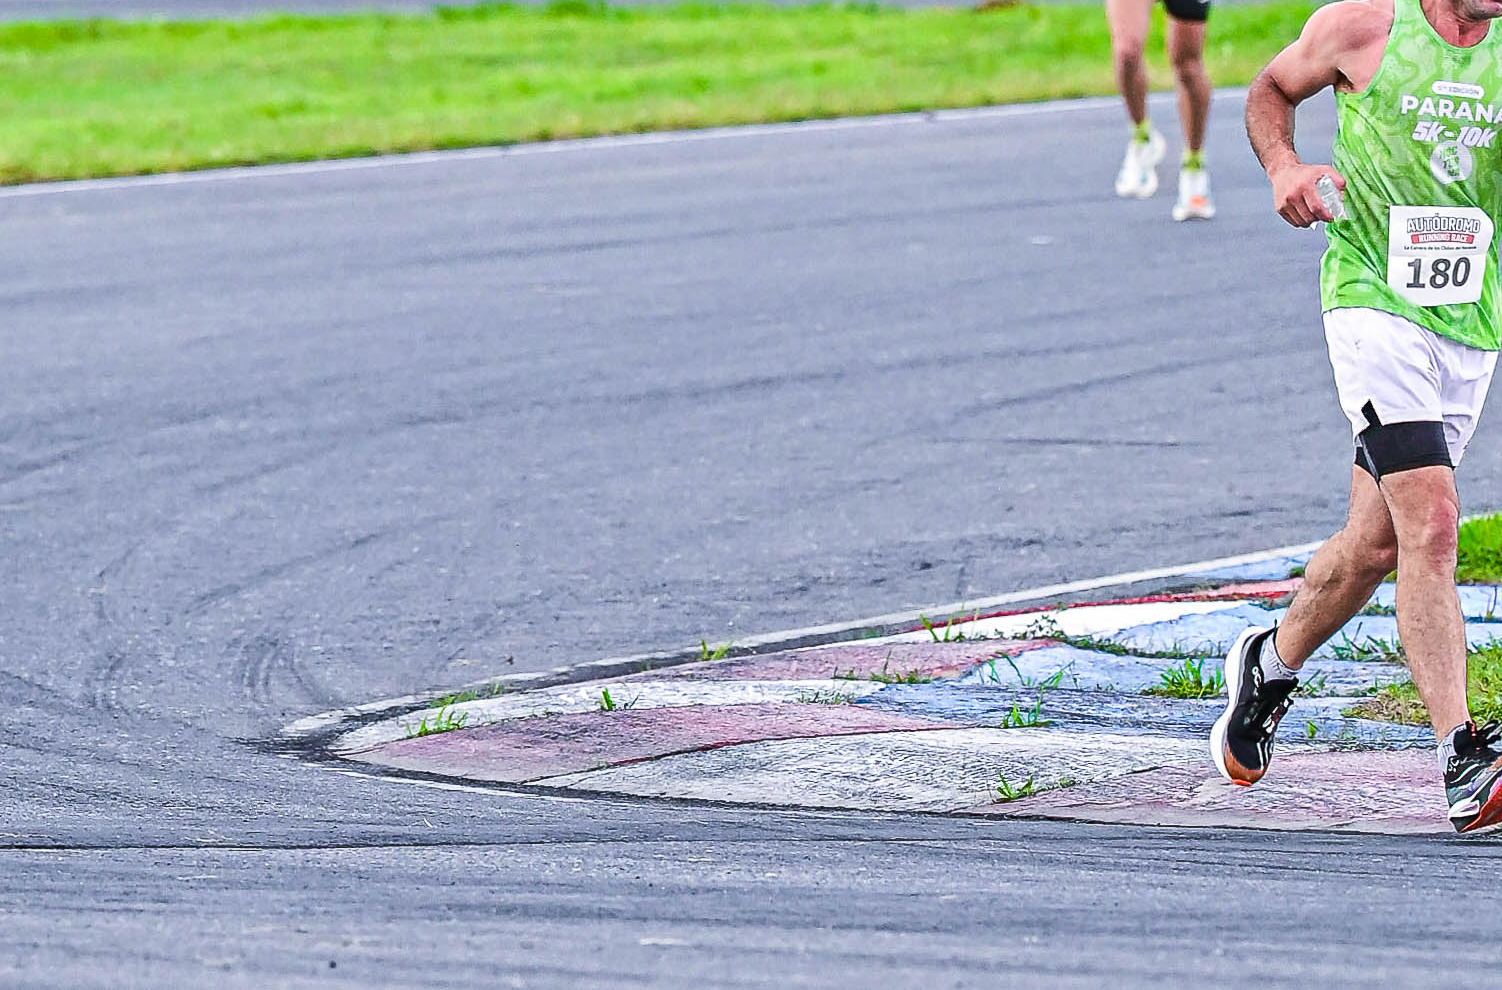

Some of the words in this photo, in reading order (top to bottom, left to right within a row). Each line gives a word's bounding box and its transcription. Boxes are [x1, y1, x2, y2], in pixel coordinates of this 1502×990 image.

[1407, 212, 1481, 233] AUTÓDROMO
[1419, 234, 1451, 243] RUNNING
[1451, 234, 1469, 243] RACE
[1406, 257, 1471, 289] 180
